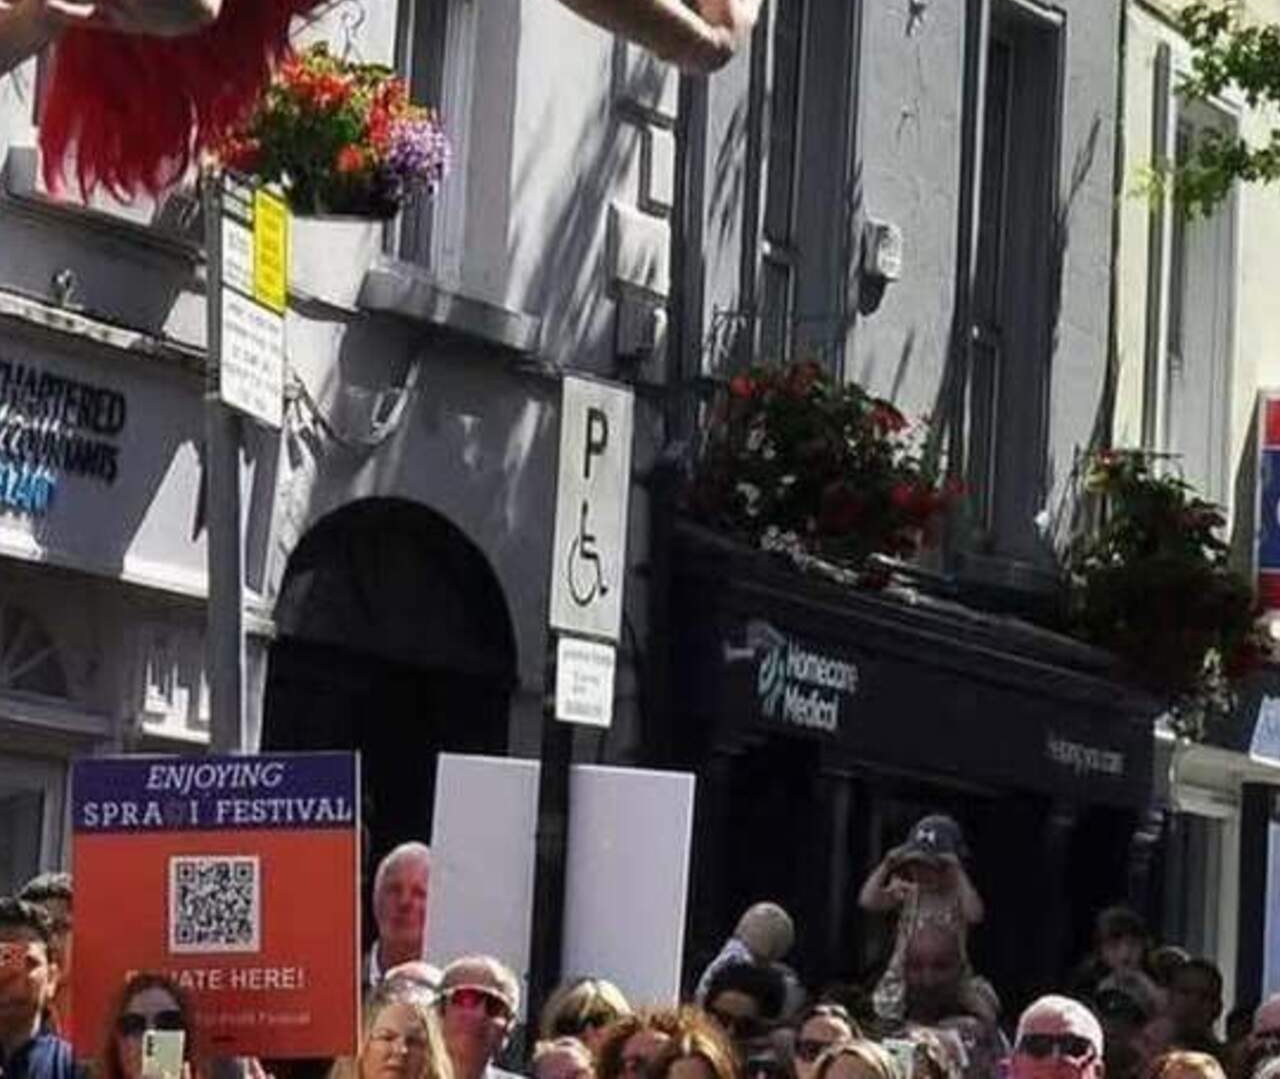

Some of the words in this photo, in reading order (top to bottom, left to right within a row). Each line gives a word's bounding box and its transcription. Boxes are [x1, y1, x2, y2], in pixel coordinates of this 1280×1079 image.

[585, 406, 609, 478] P
[785, 639, 859, 694] Homecare
[146, 763, 285, 794] ENJOYING
[82, 799, 199, 826] SPRAI
[217, 796, 353, 822] FESTIVAL
[231, 966, 304, 990] HERE!
